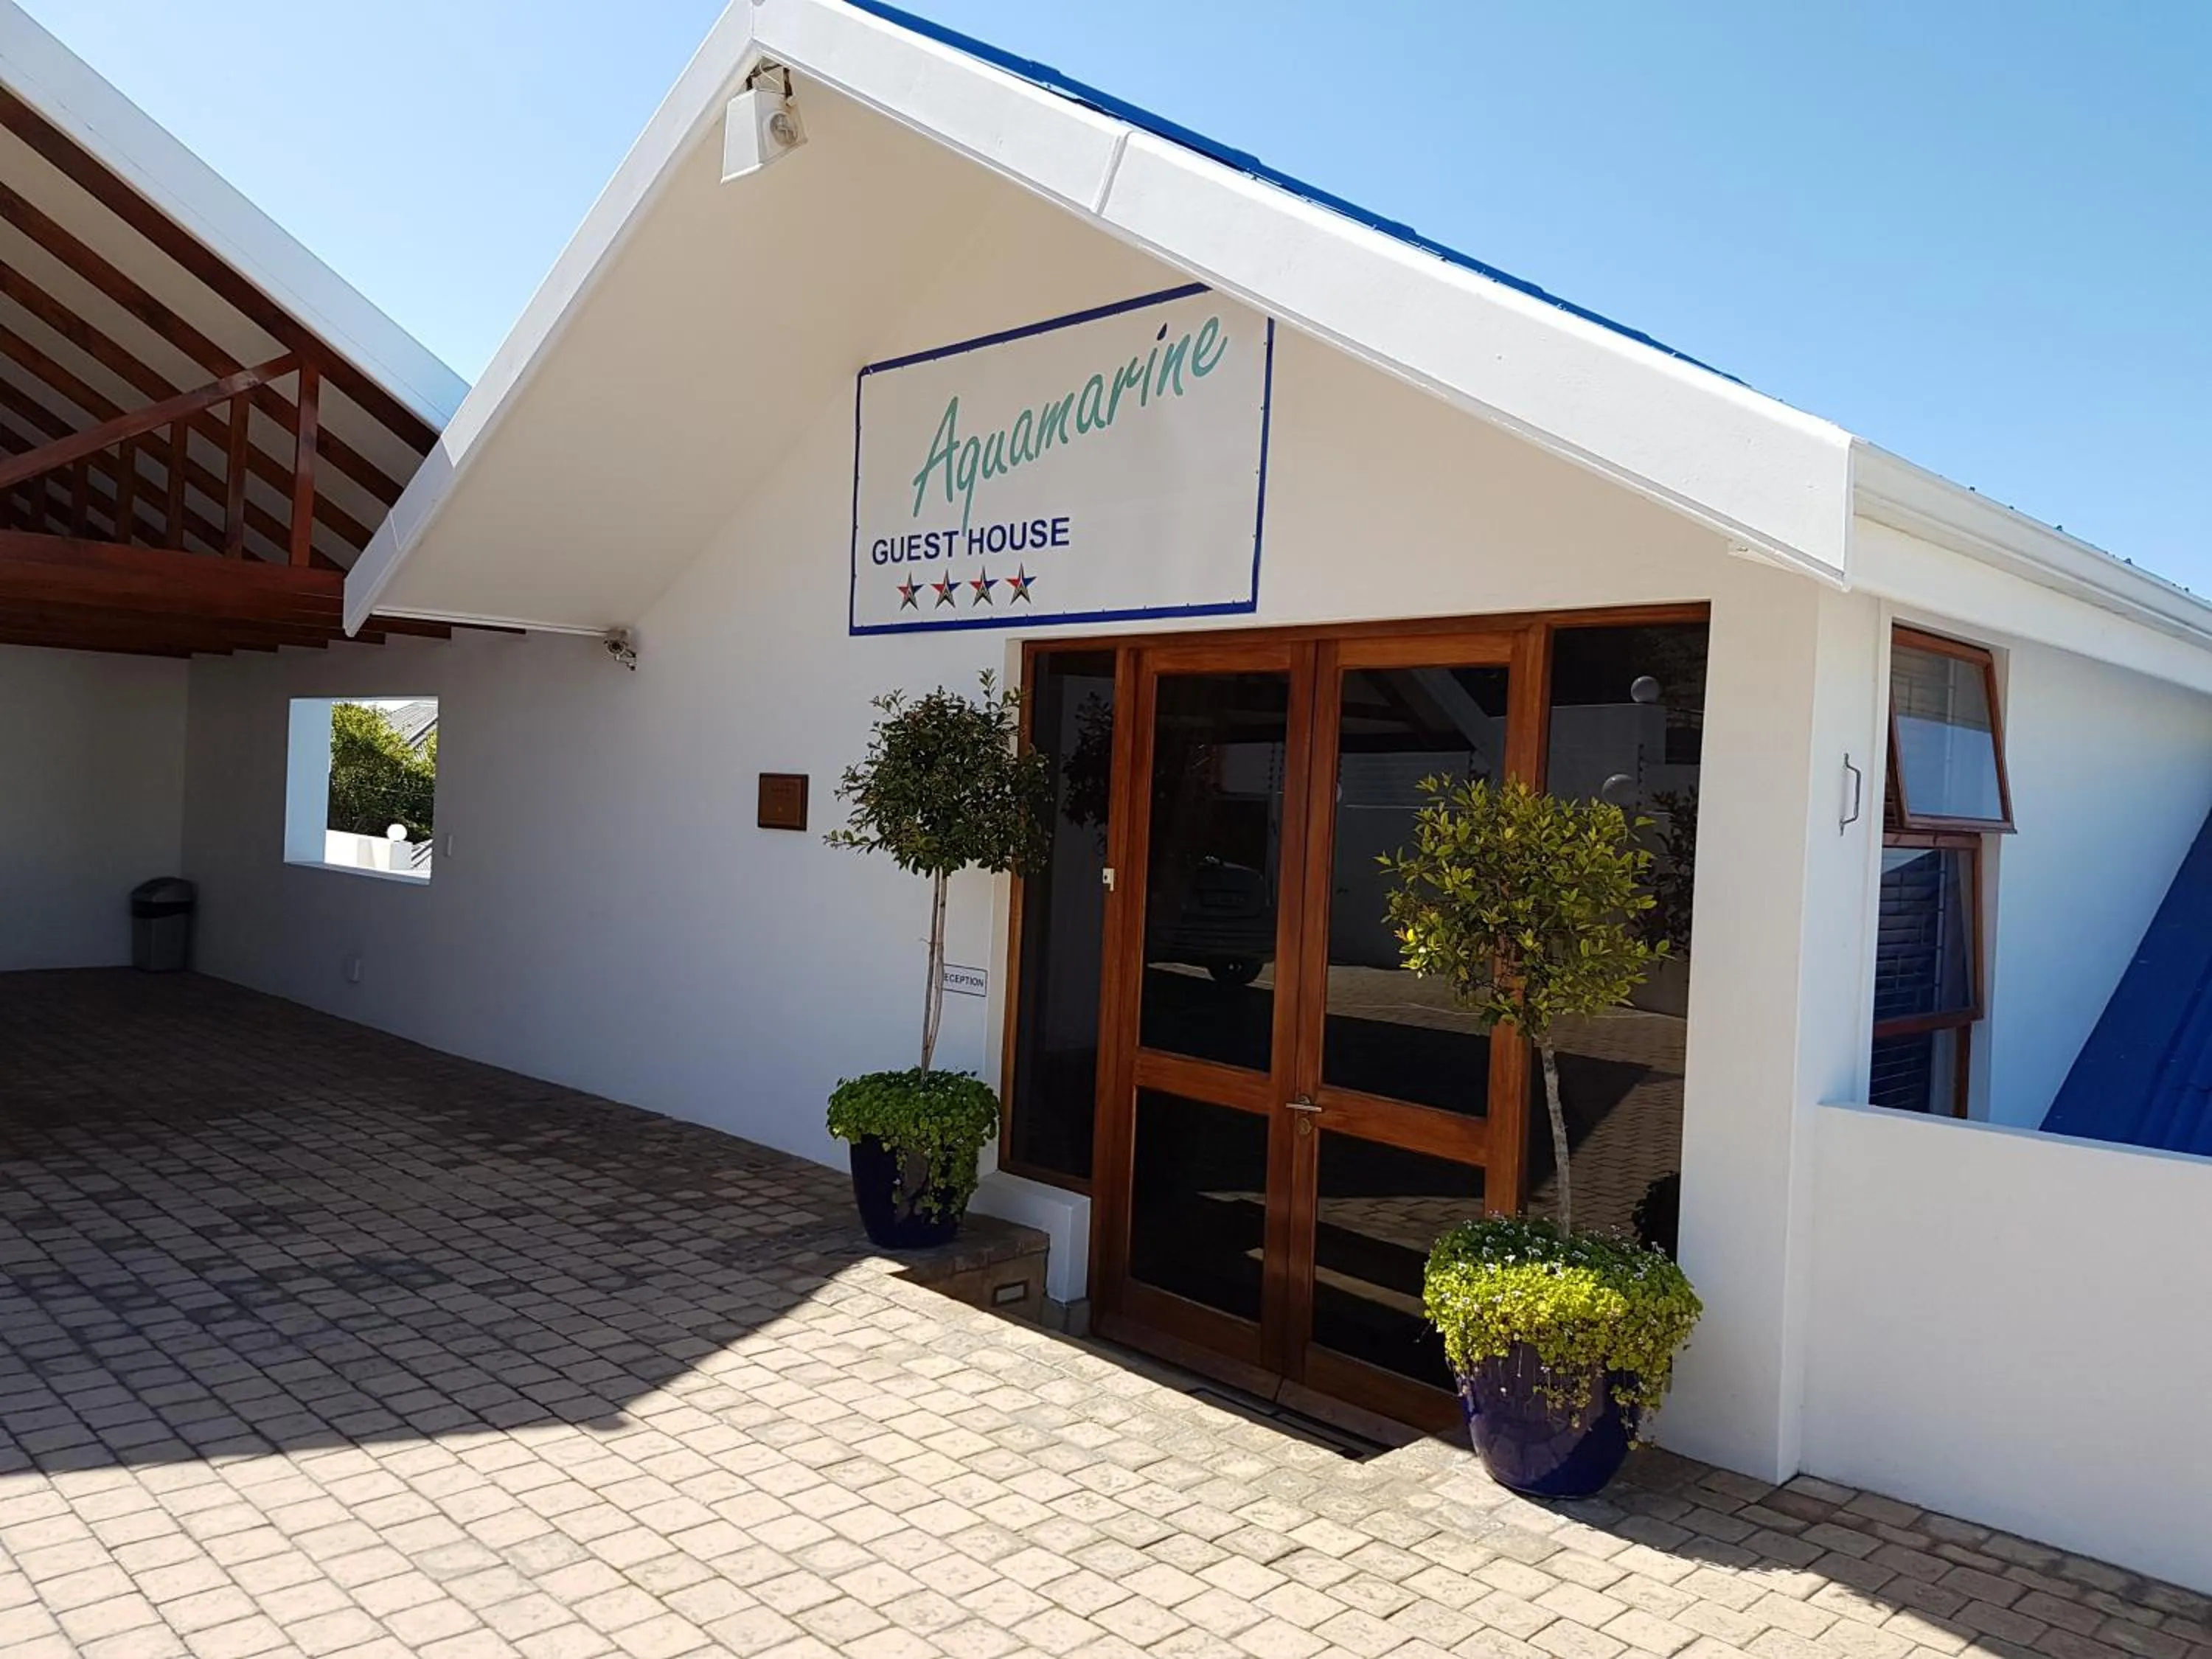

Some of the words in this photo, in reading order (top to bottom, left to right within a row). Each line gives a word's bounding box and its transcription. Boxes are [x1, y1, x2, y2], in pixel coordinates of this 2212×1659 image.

[913, 317, 1227, 536] Aquamarine
[872, 531, 959, 565] GUEST
[967, 518, 1070, 555] HOUSE
[944, 973, 984, 987] ECEPTION
